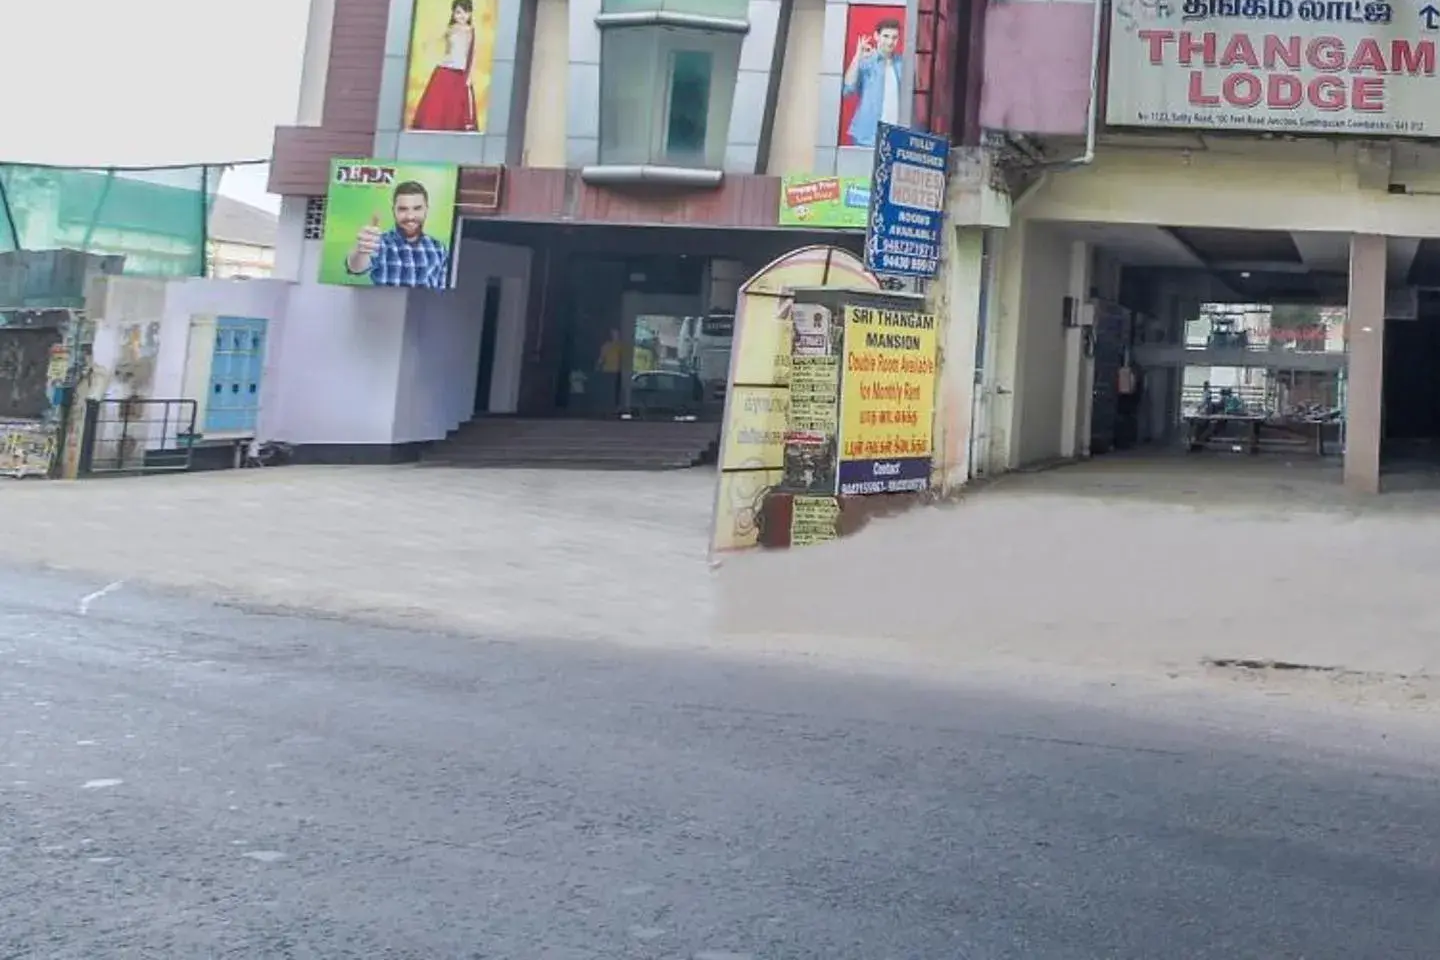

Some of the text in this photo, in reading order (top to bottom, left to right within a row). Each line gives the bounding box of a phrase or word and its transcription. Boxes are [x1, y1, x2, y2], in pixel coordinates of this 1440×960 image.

[1138, 29, 1437, 76] THANGAM
[1187, 70, 1386, 113] LODGE
[852, 309, 934, 329] SRI THANGAM
[865, 332, 920, 350] MANSION
